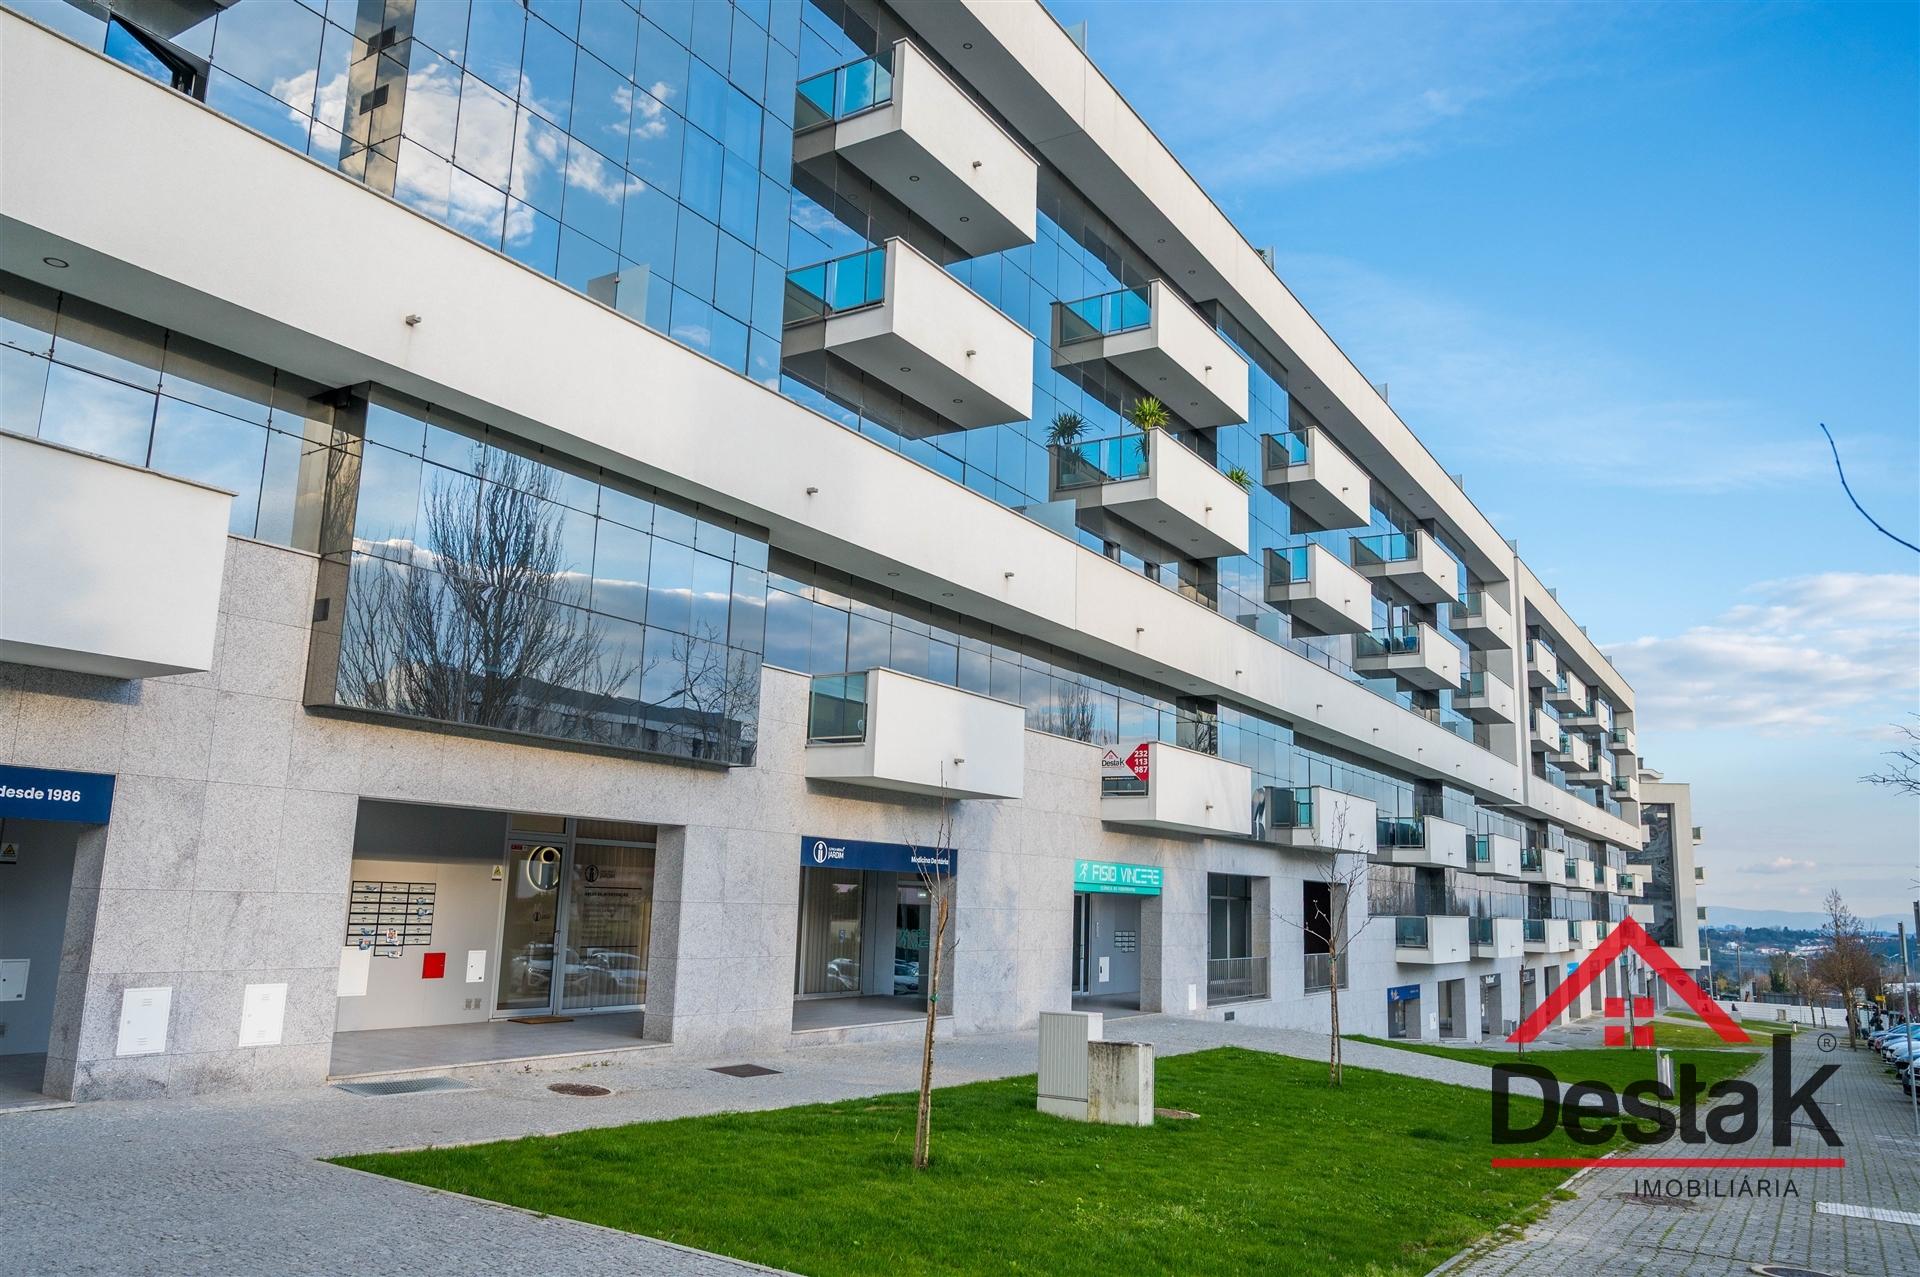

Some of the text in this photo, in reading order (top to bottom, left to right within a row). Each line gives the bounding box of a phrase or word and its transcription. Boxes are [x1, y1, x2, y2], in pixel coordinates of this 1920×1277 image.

[1134, 750, 1148, 758] 232
[1101, 757, 1125, 767] Destak
[1134, 758, 1148, 766] 113
[1134, 766, 1148, 774] 987
[0, 785, 81, 803] desde 1986
[1092, 864, 1117, 882] FISIO
